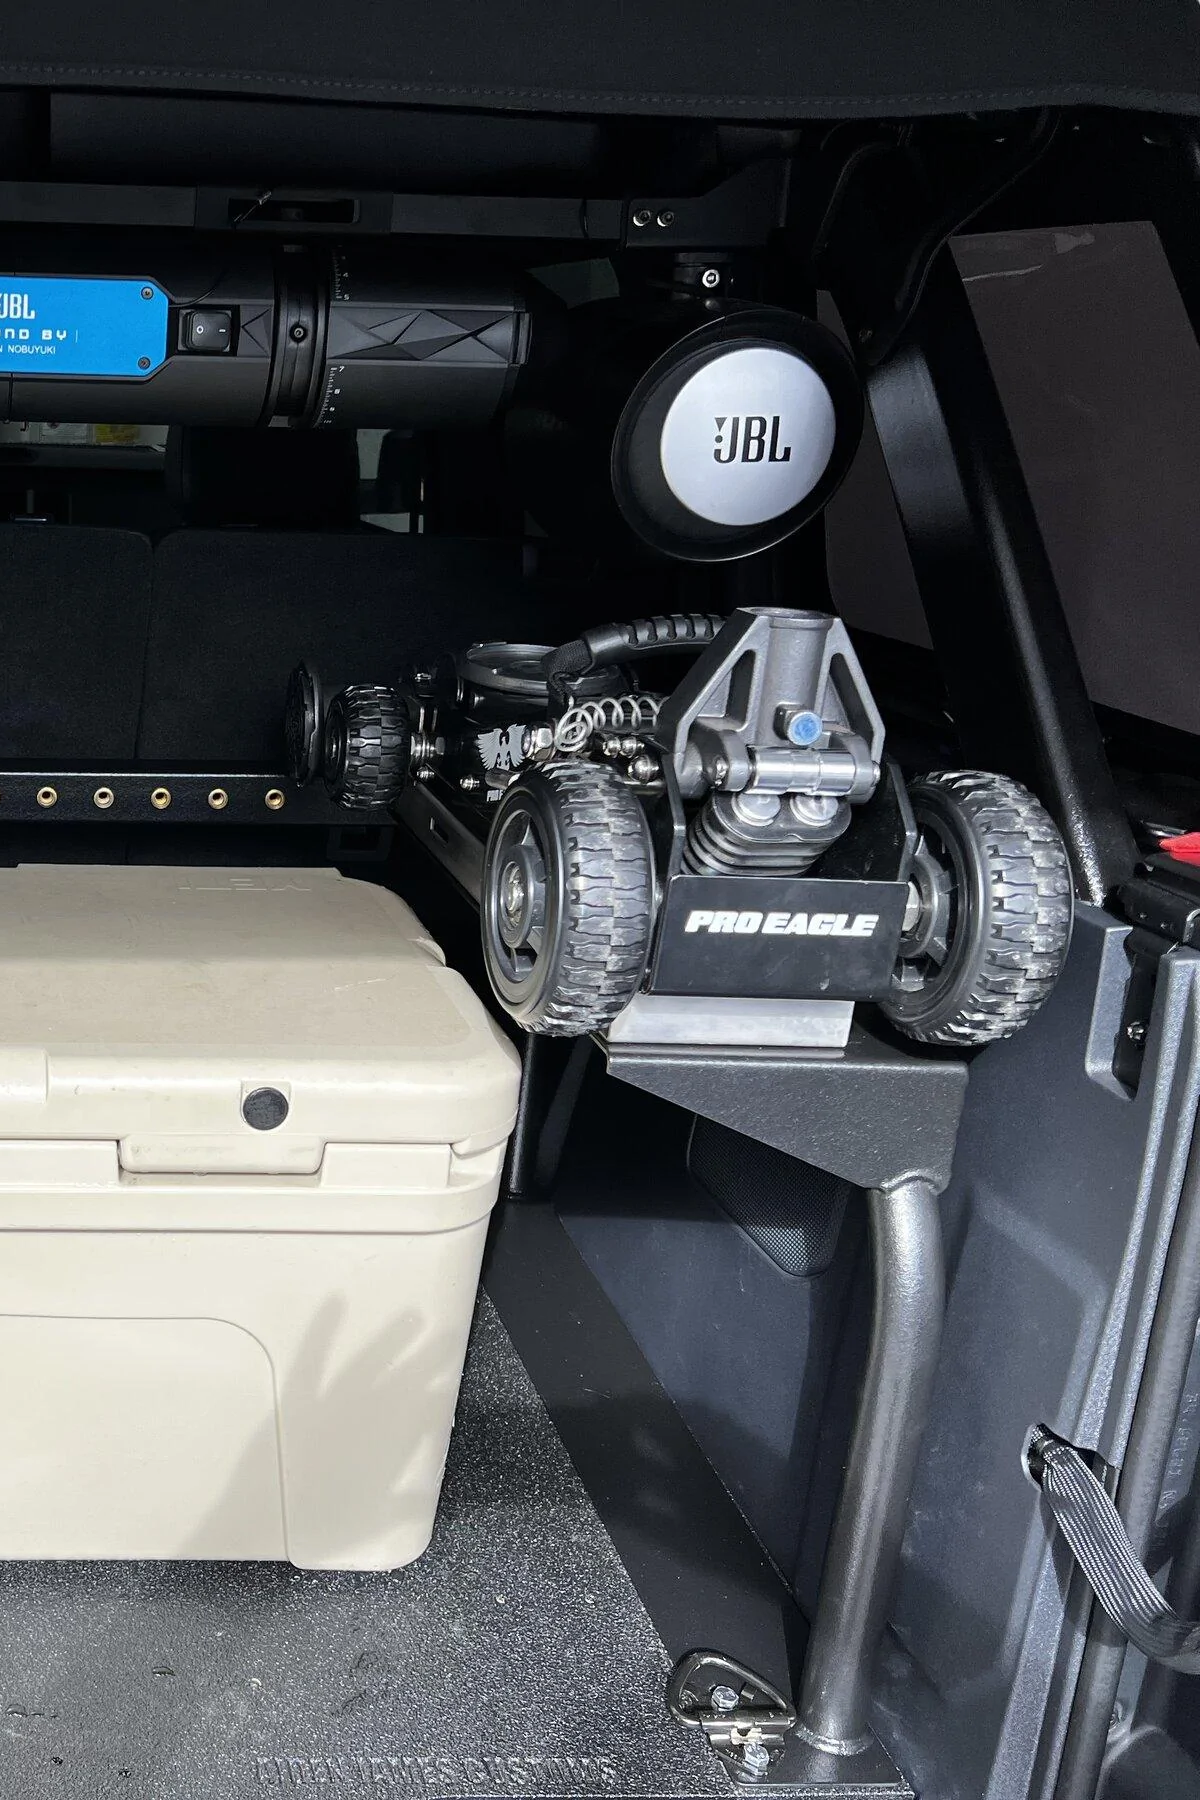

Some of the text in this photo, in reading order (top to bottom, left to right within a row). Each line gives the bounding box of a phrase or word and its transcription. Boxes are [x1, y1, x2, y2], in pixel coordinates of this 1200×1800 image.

[41, 329, 67, 341] BY
[7, 345, 56, 355] NOBUYUKI
[713, 415, 792, 464] JBL
[684, 910, 880, 938] PRO EAGLE
